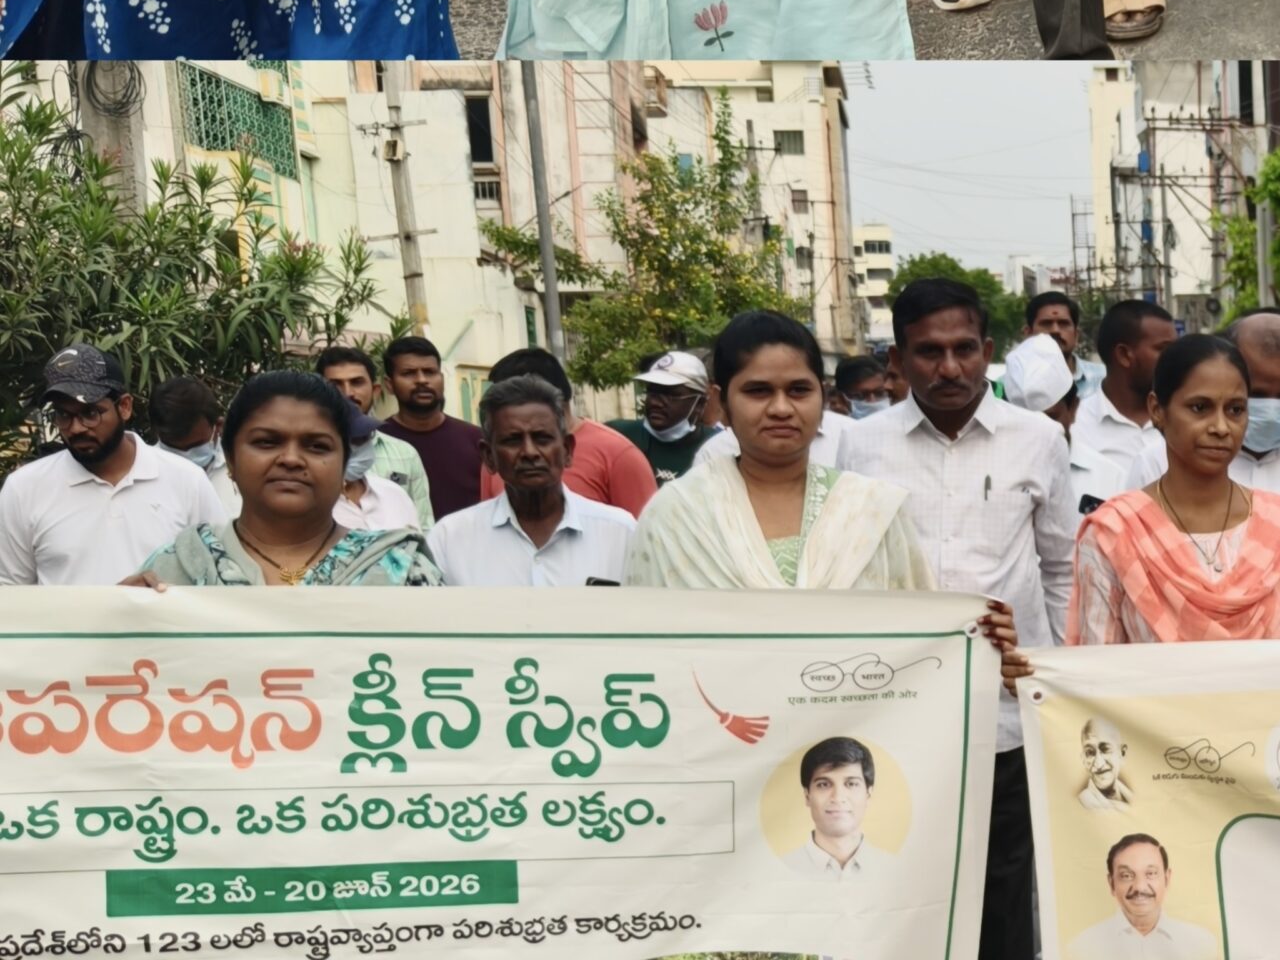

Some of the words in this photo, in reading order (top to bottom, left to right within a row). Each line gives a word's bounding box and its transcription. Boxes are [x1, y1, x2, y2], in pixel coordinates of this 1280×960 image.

[0, 658, 322, 769] పరేషన్
[340, 652, 482, 774] క్లీన్
[504, 657, 671, 778] స్వీప్
[810, 694, 837, 704] कदम
[74, 795, 221, 863] రాష్ట్రం.
[236, 795, 307, 835] ఒక
[320, 791, 528, 843] పరిశుభ్రత
[541, 790, 666, 843] లక్ష్యం.
[175, 882, 217, 904] 23
[224, 875, 257, 903] మే
[284, 880, 327, 901] 20
[333, 870, 392, 899] జూన్
[399, 873, 481, 898] 2026
[137, 931, 202, 953] 123
[209, 922, 266, 950] లలో
[452, 914, 568, 944] పరిశుభ్రత
[574, 910, 702, 943] కార్యక్రమం.
